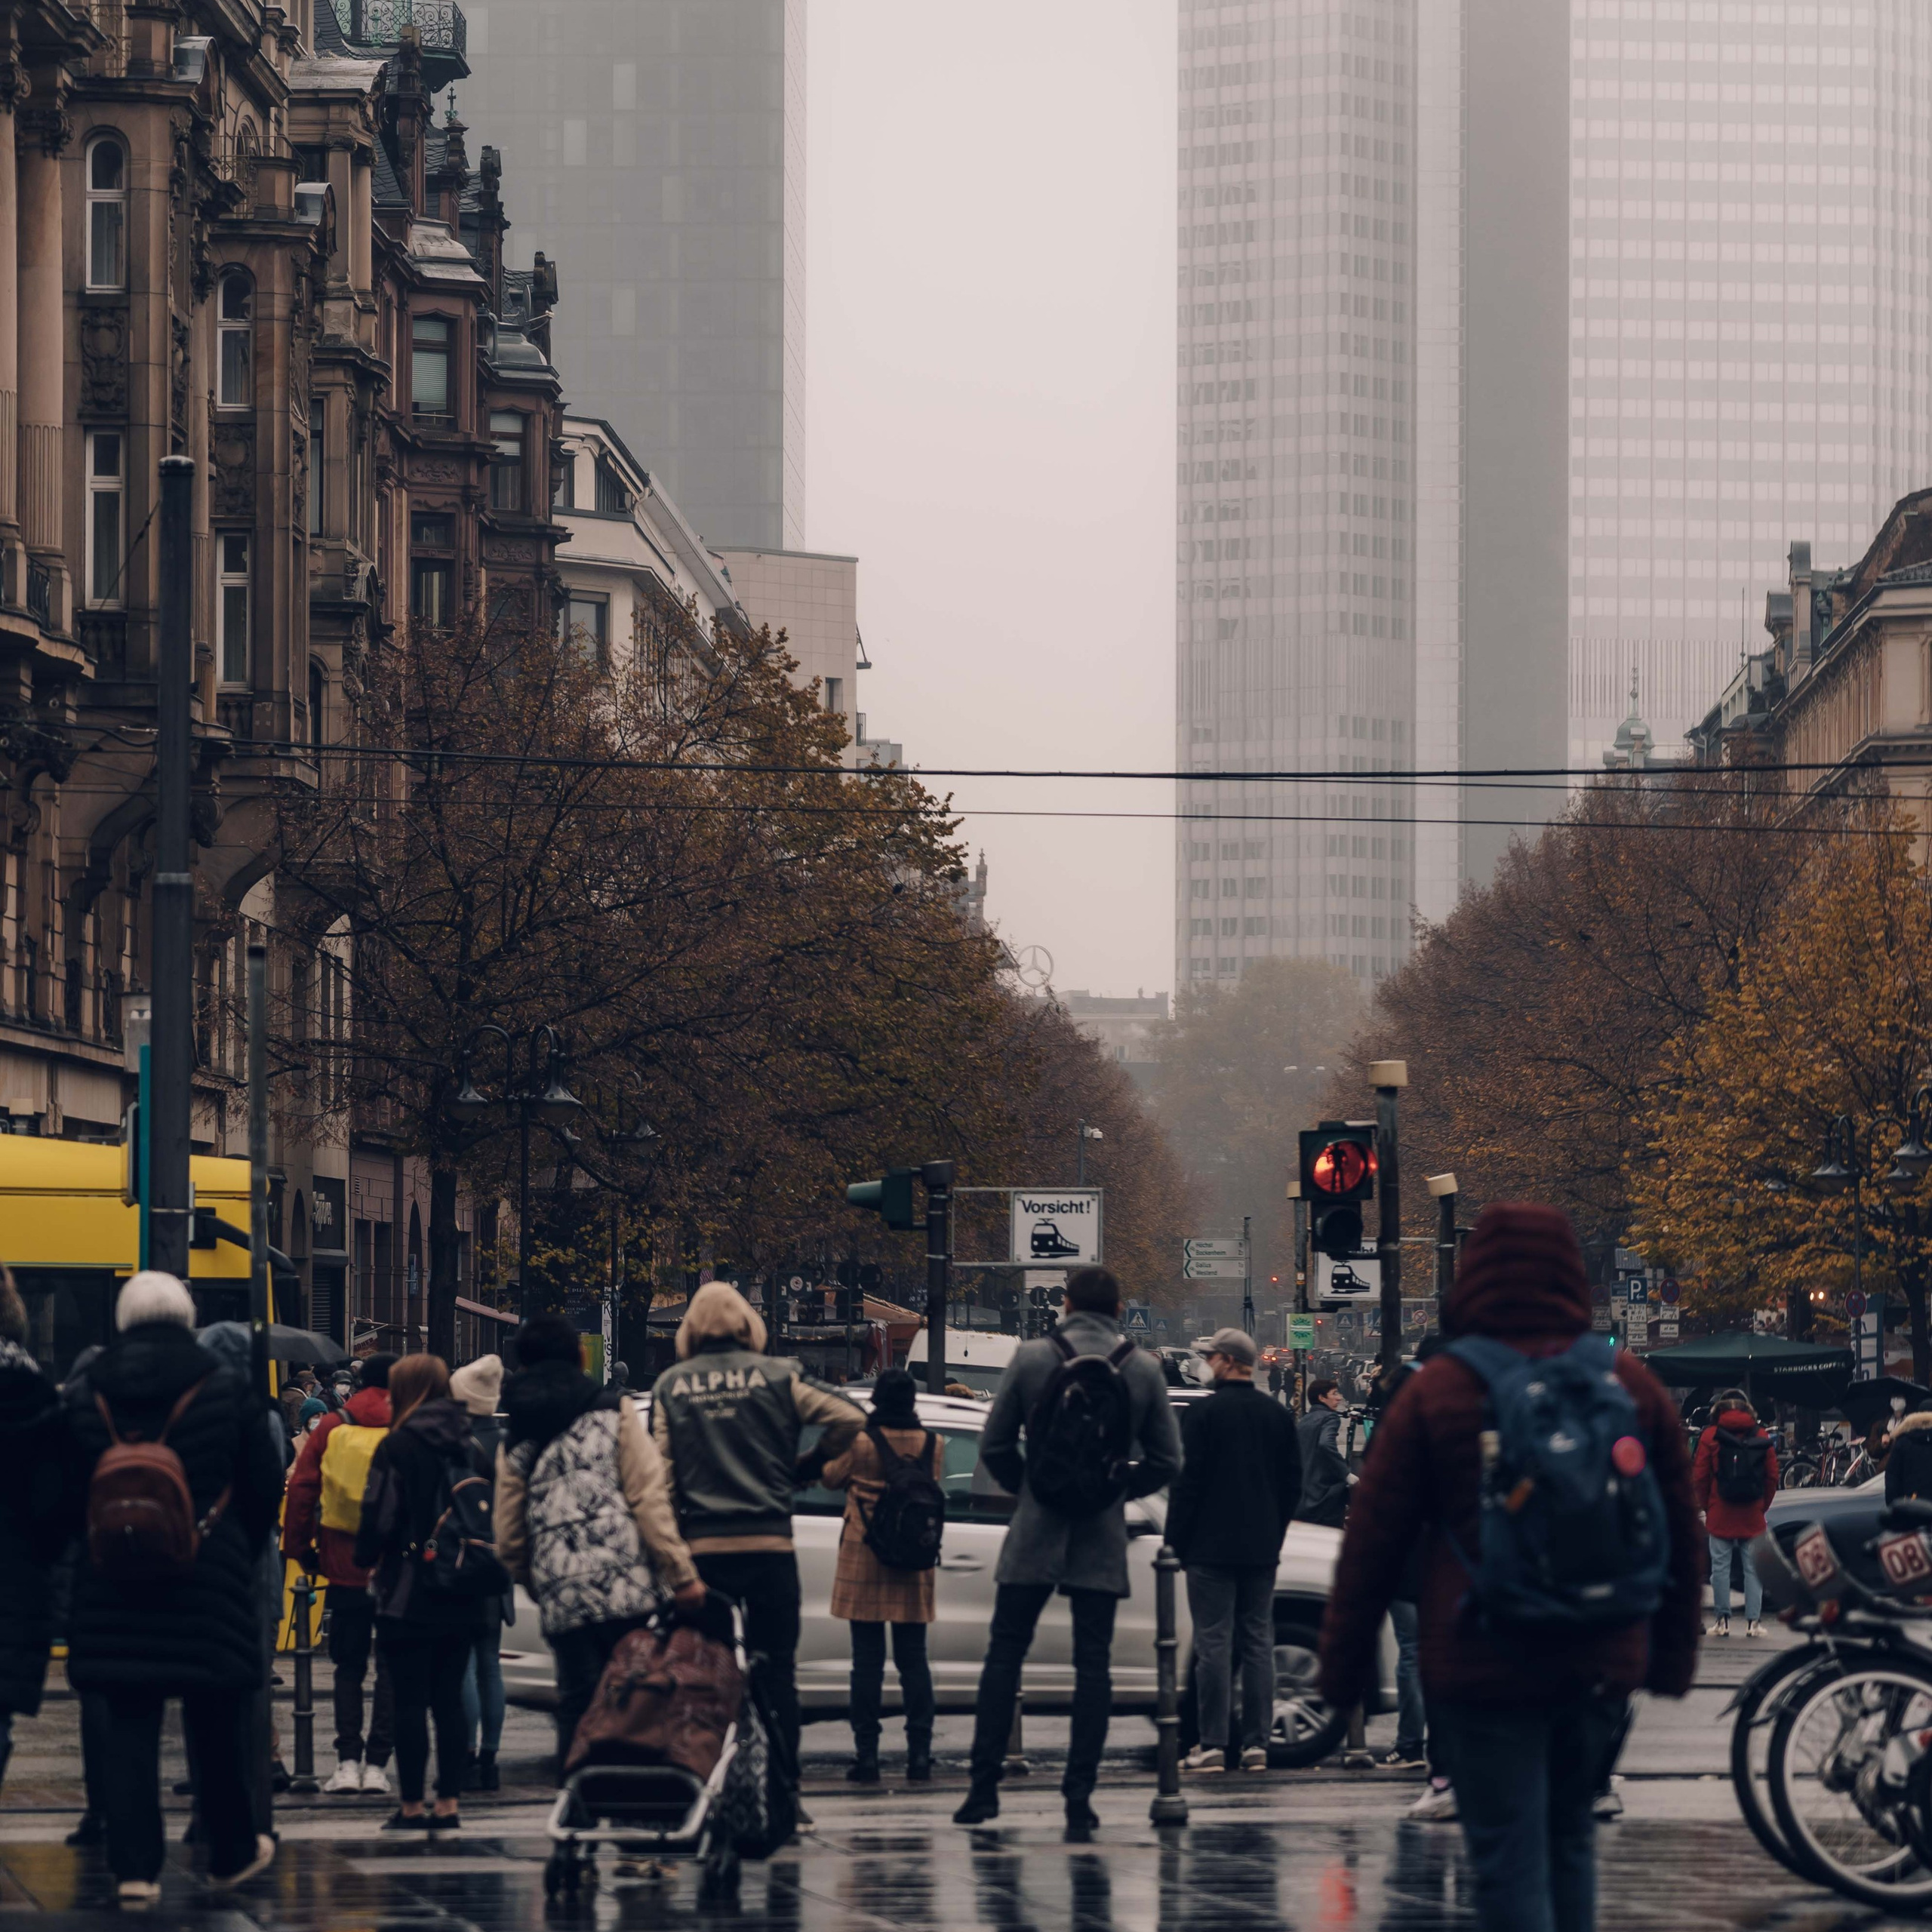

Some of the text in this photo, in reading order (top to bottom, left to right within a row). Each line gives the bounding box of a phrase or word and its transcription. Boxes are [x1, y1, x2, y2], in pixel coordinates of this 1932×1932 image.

[1021, 1200, 1091, 1214] Vorsicht!
[1630, 1280, 1641, 1300] P
[1774, 1361, 1846, 1374] STARBUCKS COFFEE
[671, 1367, 768, 1396] ALPHA
